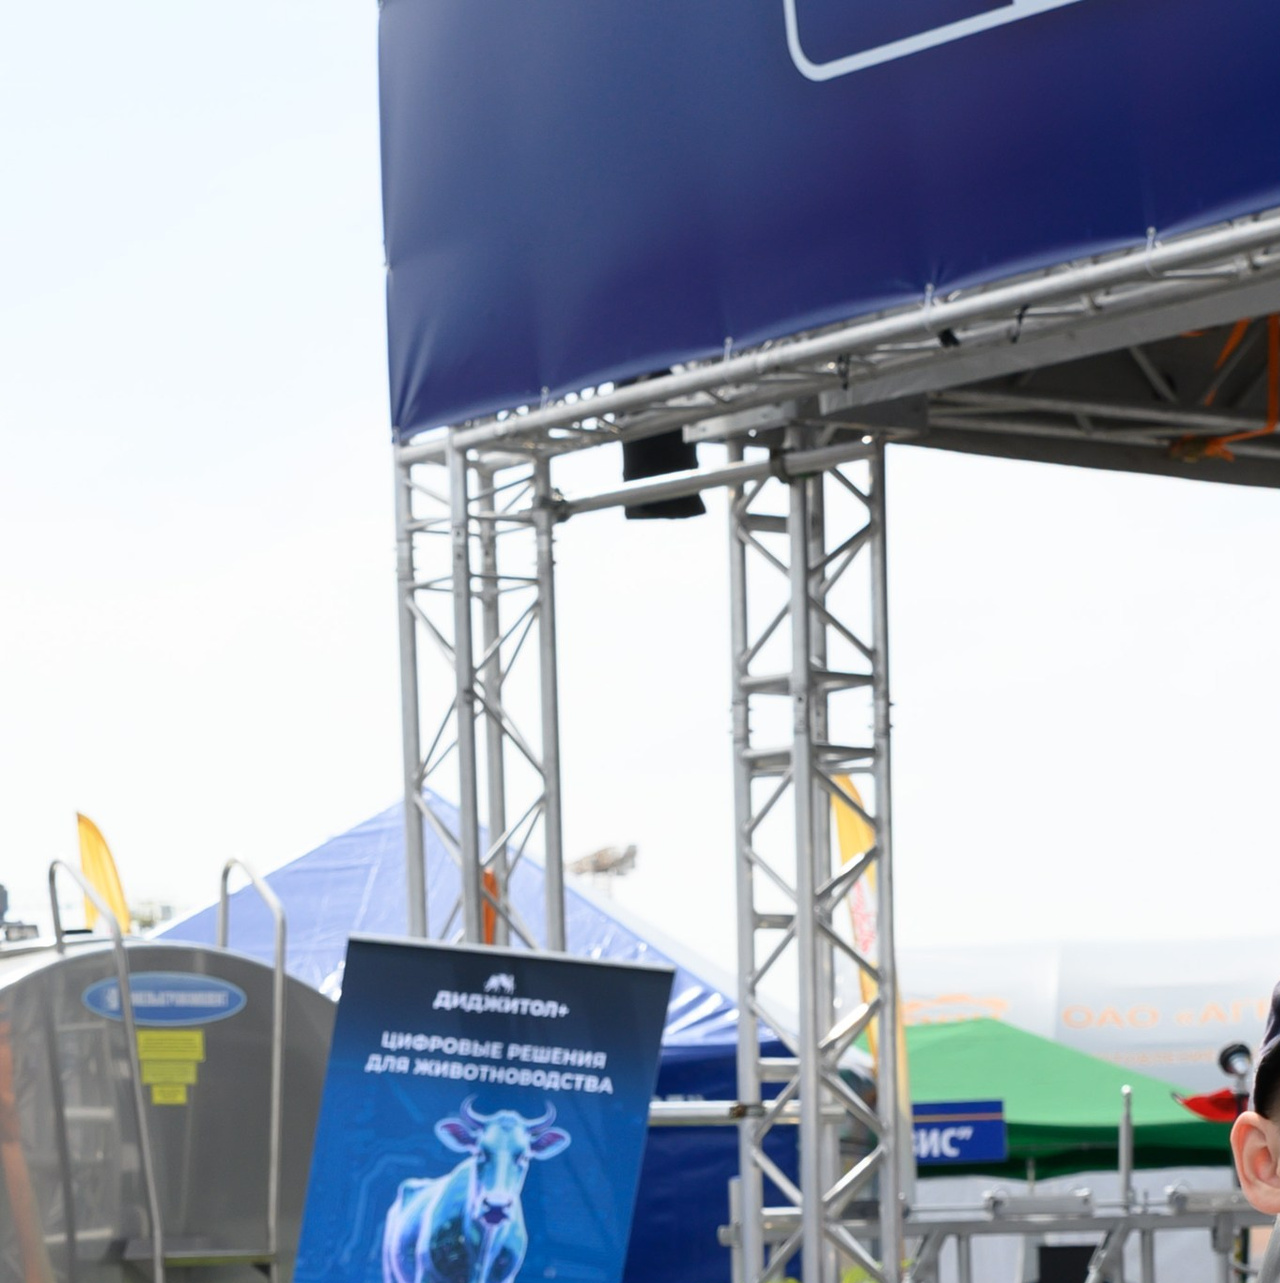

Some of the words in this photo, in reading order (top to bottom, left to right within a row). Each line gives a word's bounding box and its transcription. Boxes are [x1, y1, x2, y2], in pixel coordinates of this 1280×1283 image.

[432, 990, 570, 1018] ДИДЖИТОЛ+
[1063, 1005, 1159, 1029] ОАО
[381, 1031, 503, 1060] ЦИФРОВЫЕ
[507, 1043, 608, 1070] РЕШЕНИЯ
[364, 1053, 410, 1075] ДЛЯ
[413, 1058, 614, 1095] ЖИВОТНОВОДСТВА
